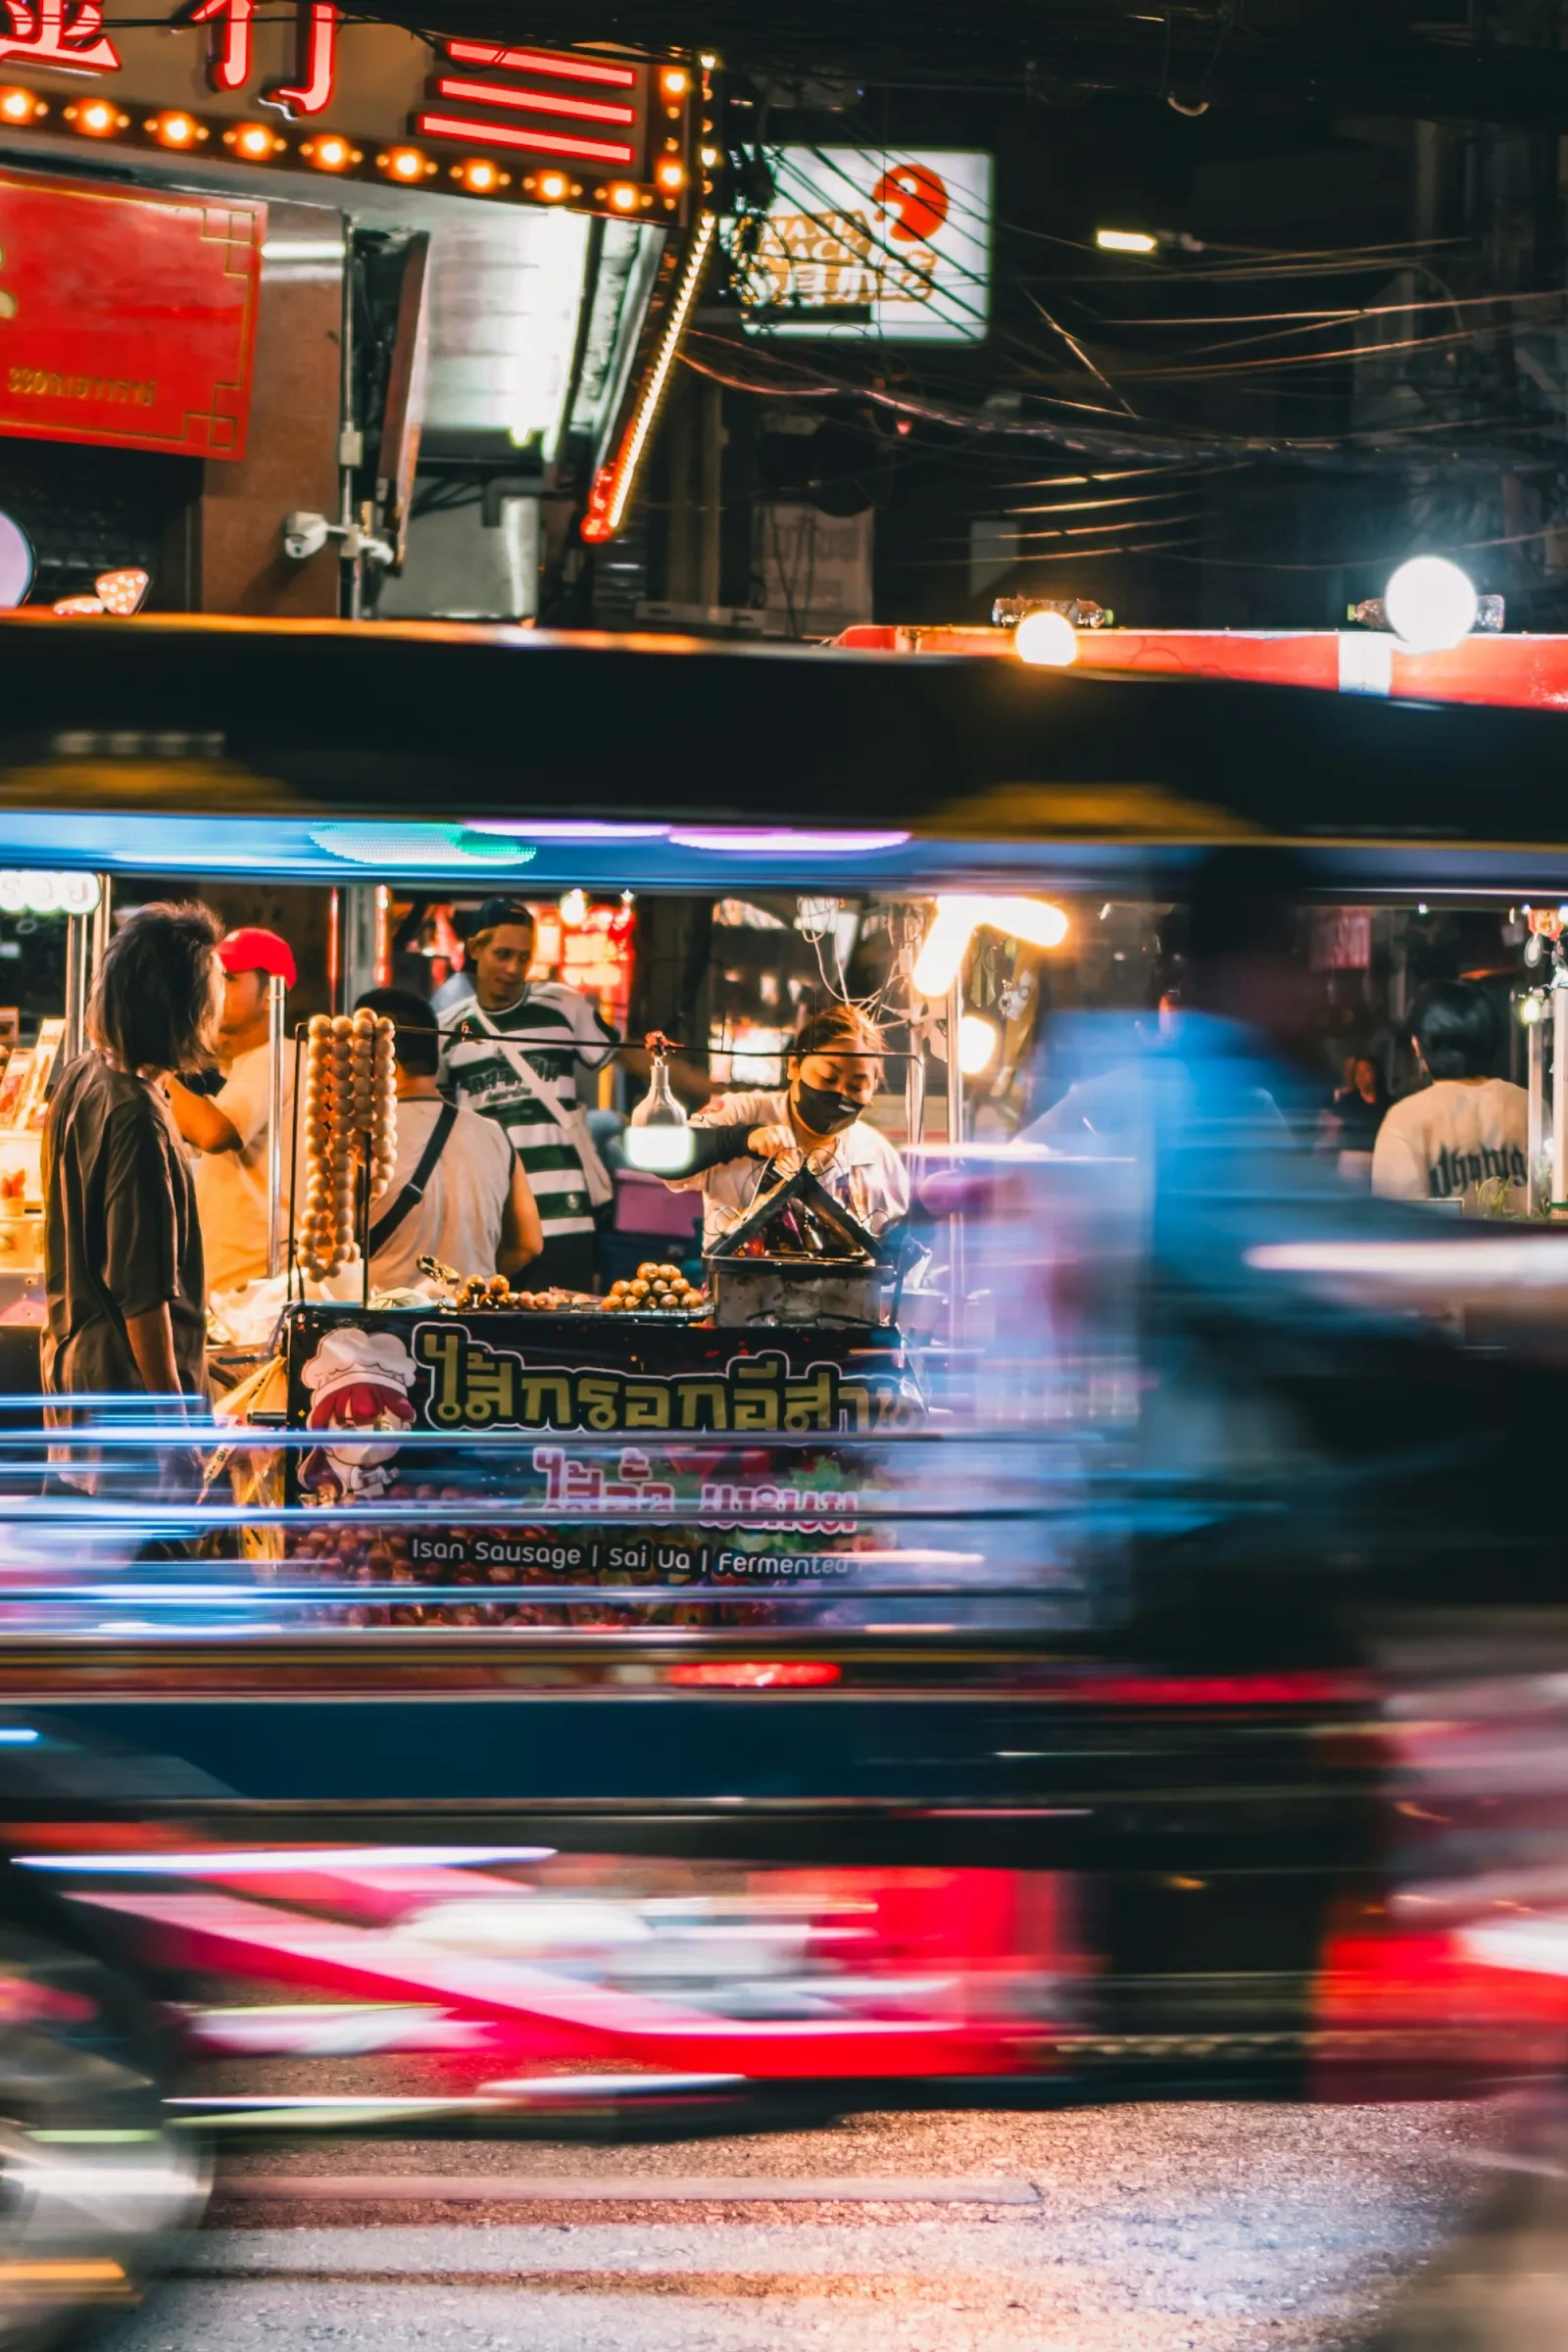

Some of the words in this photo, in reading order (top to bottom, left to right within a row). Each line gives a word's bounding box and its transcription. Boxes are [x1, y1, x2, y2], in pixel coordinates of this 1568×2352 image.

[412, 1538, 465, 1560] Isan
[474, 1541, 582, 1569] Sausage
[608, 1544, 648, 1568] Sai
[657, 1548, 691, 1570] Ua
[717, 1551, 851, 1575] Fermented
